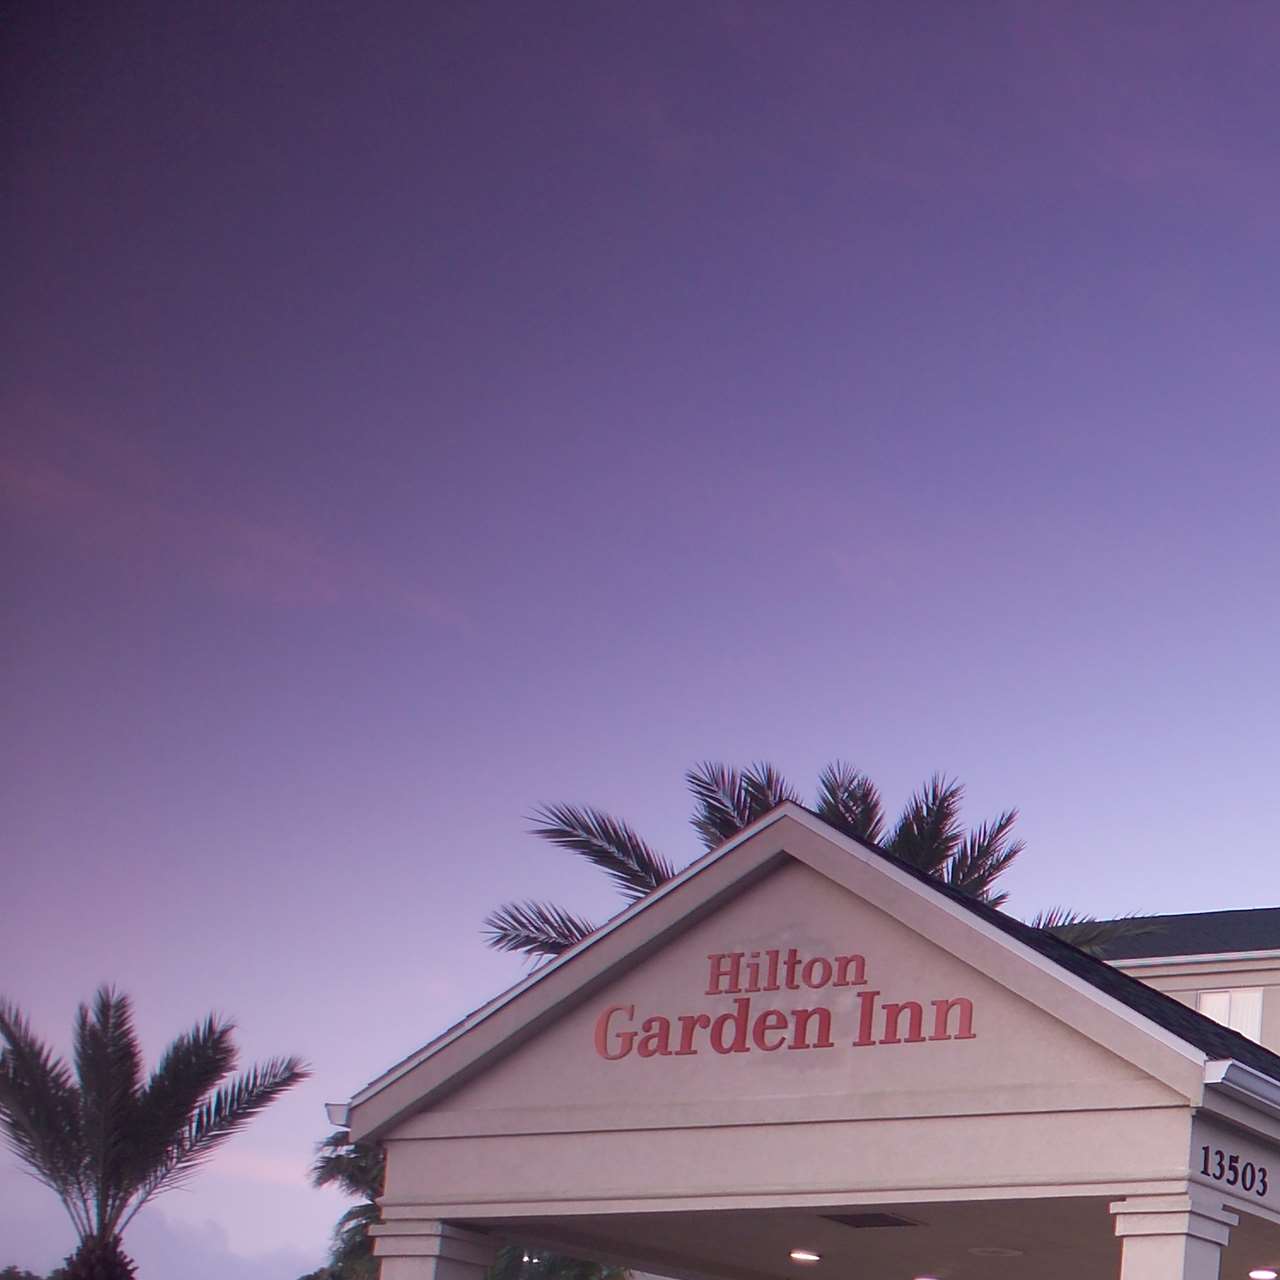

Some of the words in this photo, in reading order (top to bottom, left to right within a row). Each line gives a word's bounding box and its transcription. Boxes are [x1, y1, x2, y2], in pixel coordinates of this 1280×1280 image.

[704, 948, 867, 996] Hilton
[594, 998, 834, 1060] Garden
[852, 990, 976, 1047] Inn
[1201, 1145, 1268, 1197] 13503
